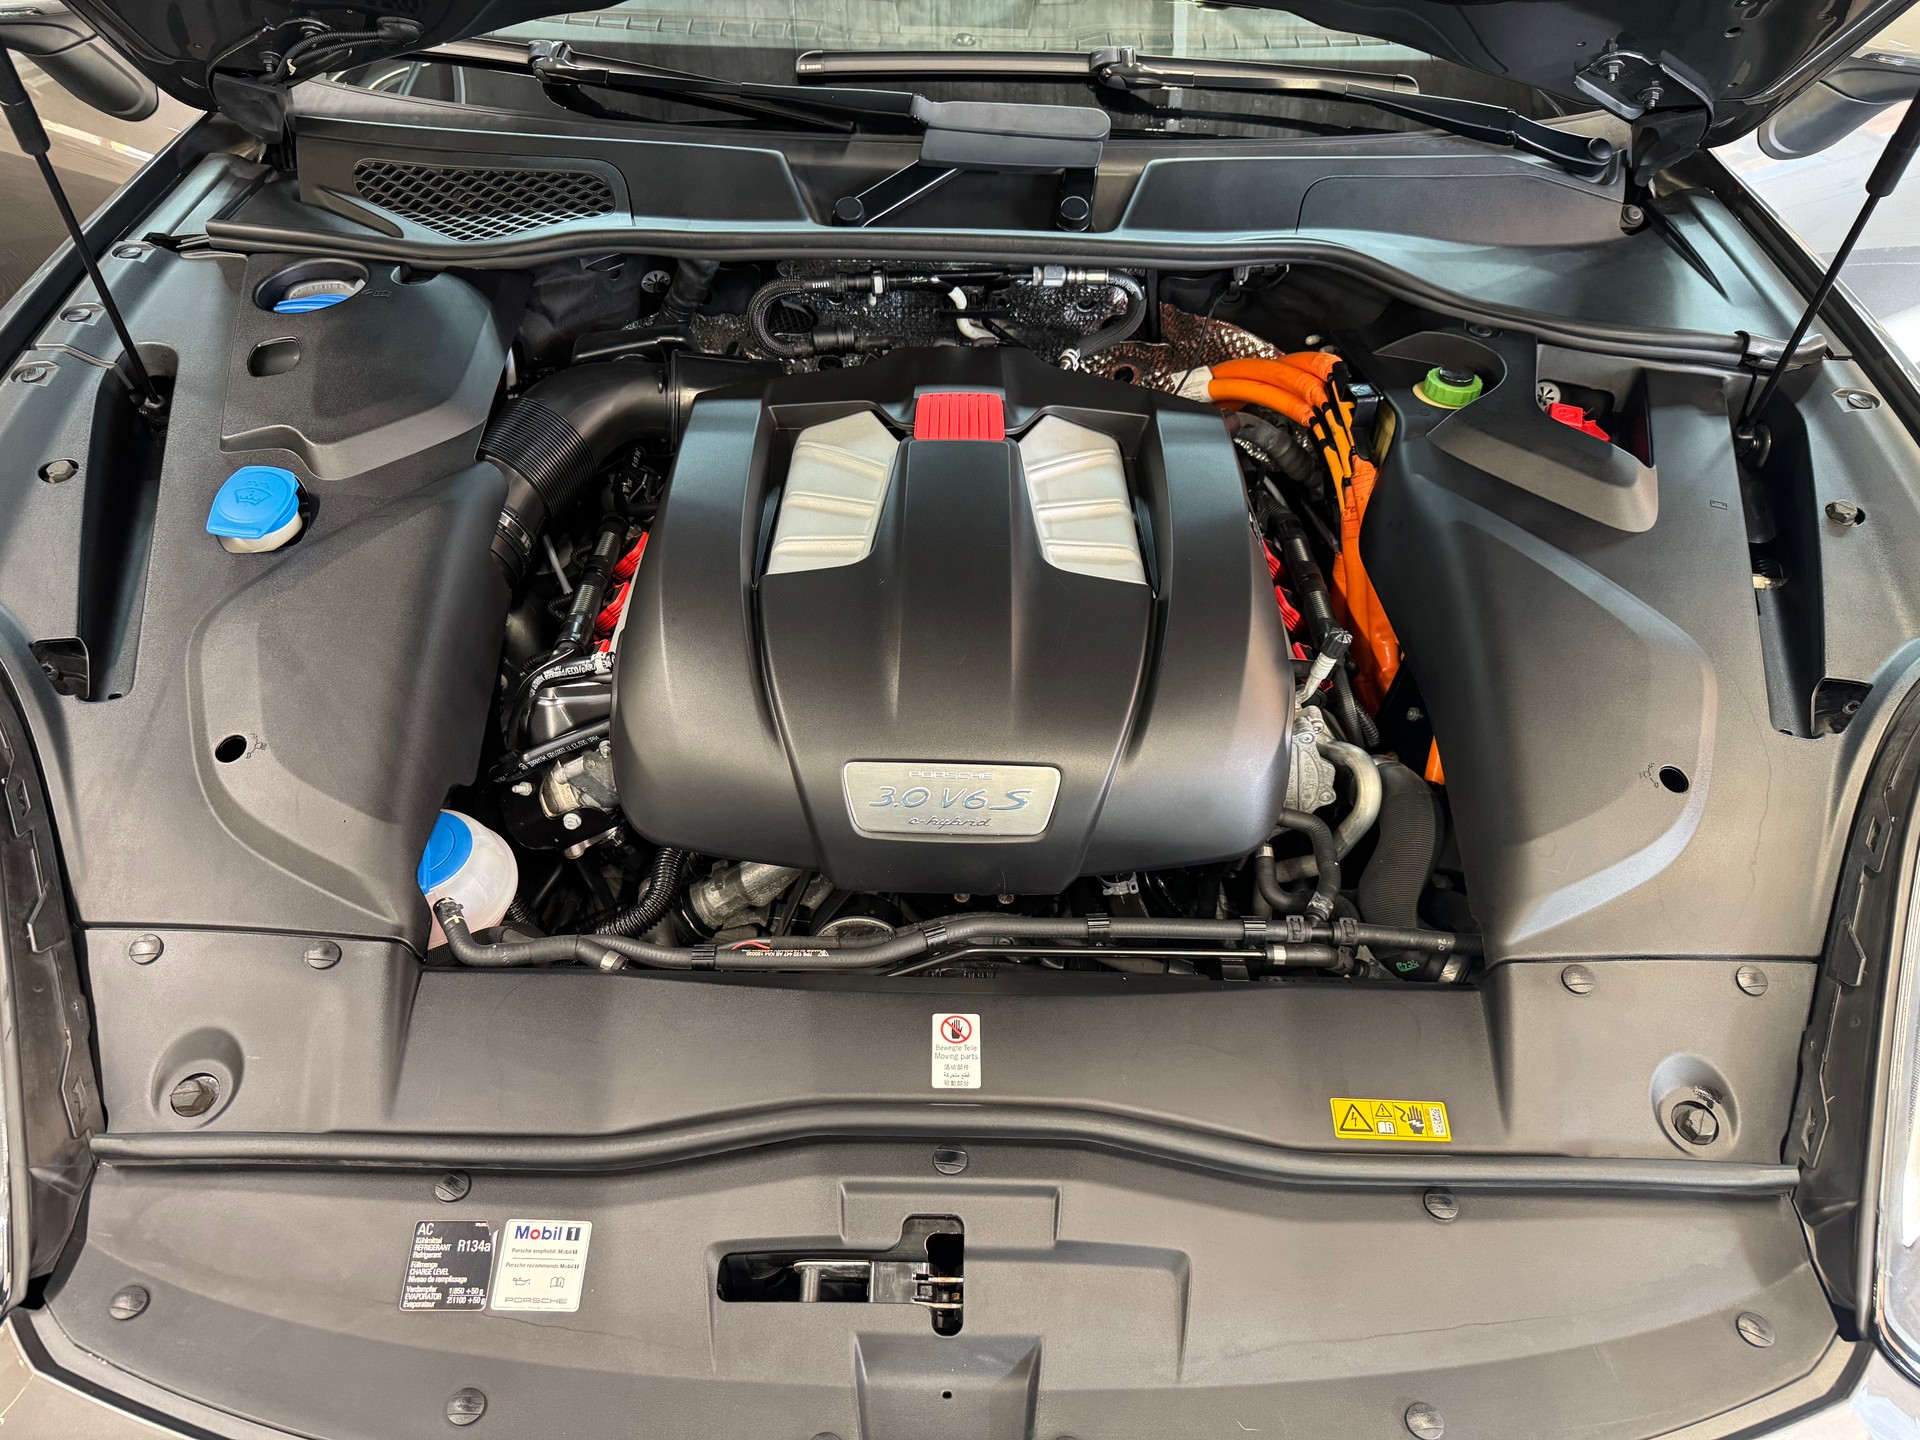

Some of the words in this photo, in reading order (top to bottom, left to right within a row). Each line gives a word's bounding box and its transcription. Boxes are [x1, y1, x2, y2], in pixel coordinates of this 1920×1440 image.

[909, 770, 994, 780] PORSCHE
[869, 786, 931, 808] 3.0
[942, 788, 988, 810] V6
[990, 788, 1032, 810] S
[909, 816, 992, 830] e-hybrid
[935, 1052, 958, 1060] Moving
[417, 1223, 434, 1235] AC
[515, 1225, 562, 1240] Mobil
[457, 1240, 491, 1252] R134a
[435, 1276, 468, 1284] remplissage
[406, 1286, 438, 1294] Verdampfer
